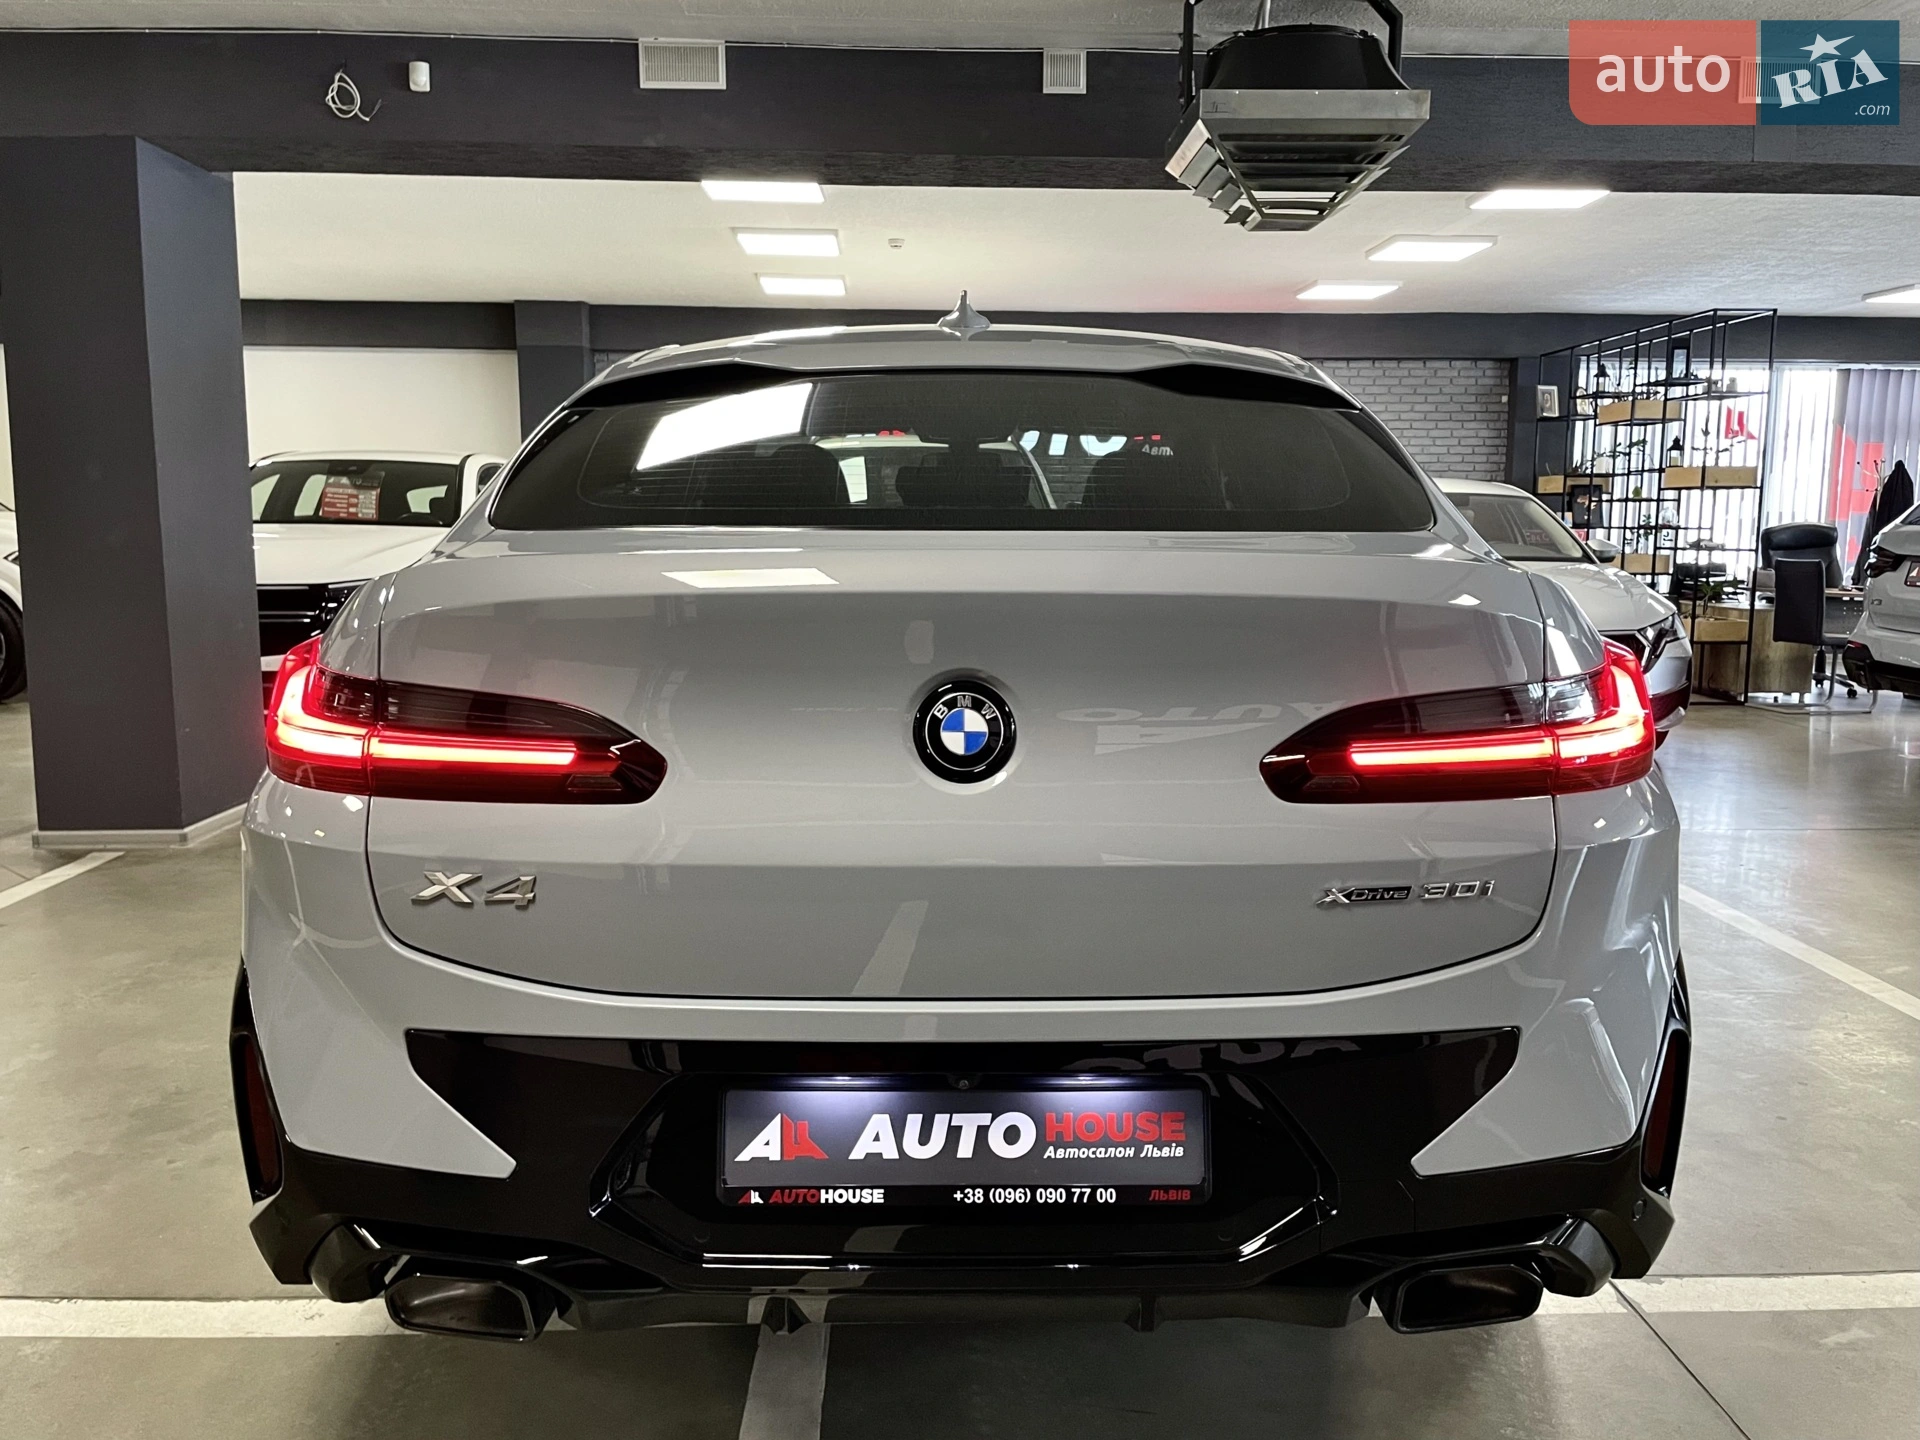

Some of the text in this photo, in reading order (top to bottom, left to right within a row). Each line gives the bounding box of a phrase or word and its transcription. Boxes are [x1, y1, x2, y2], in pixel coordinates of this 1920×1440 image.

[933, 695, 997, 720] BMW
[410, 871, 538, 909] X4
[848, 1111, 1037, 1160] AUTO
[1044, 1111, 1186, 1142] HOUSE
[1043, 1142, 1185, 1160] Автосалон Львів
[953, 1187, 1117, 1204] +38 (096) 090 77 00
[1149, 1189, 1191, 1202] ЛЬВІВ
